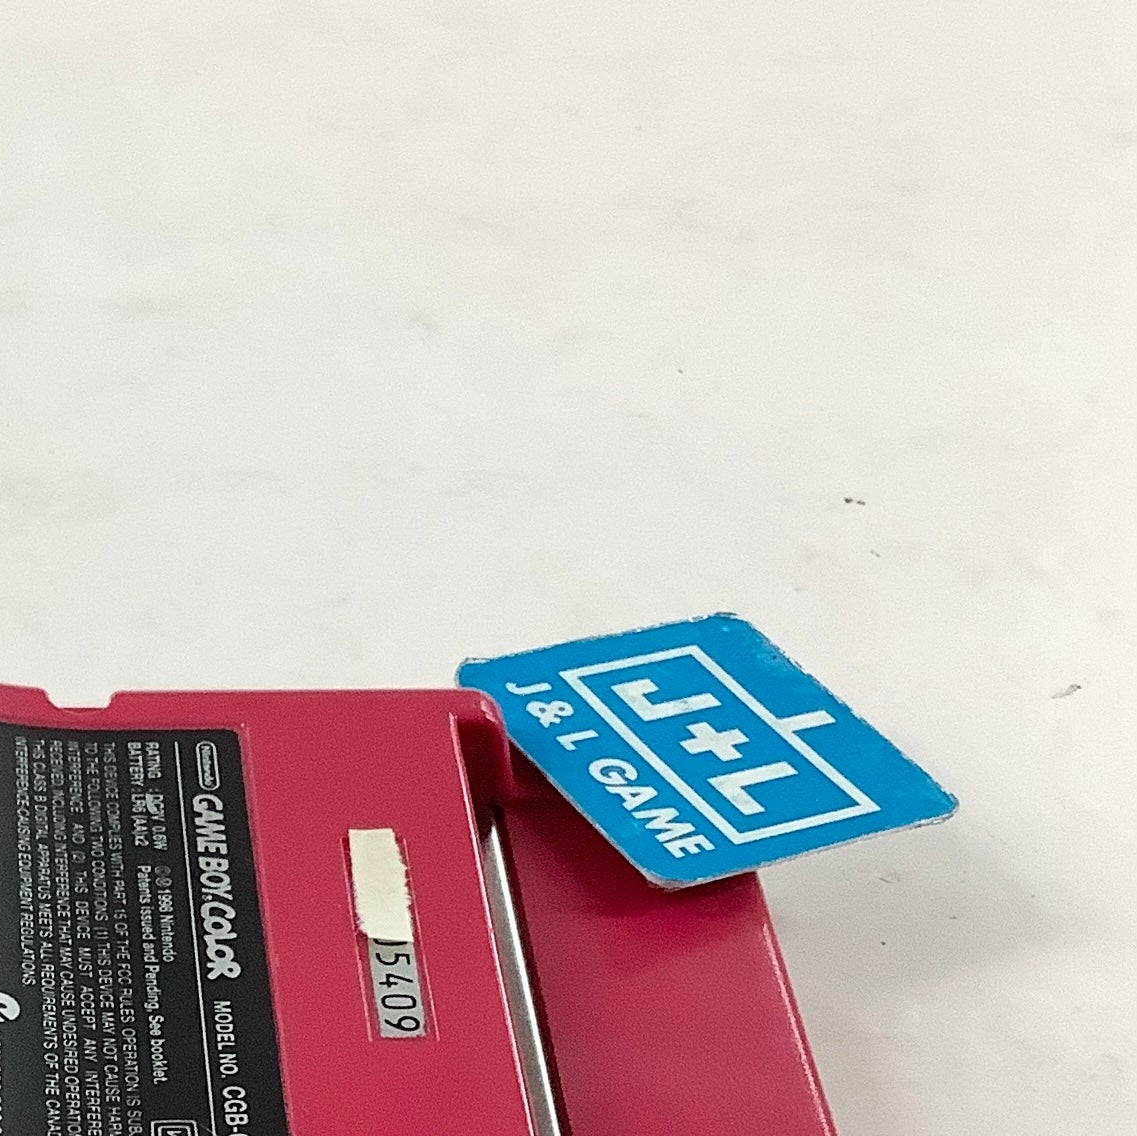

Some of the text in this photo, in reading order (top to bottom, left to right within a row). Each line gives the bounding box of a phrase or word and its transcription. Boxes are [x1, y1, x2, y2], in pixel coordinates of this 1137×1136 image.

[32, 740, 45, 758] THIS
[85, 743, 98, 754] TO
[104, 742, 116, 763] THIS
[146, 742, 161, 778] RATING
[33, 762, 46, 792] CLASS
[87, 758, 98, 774] THE
[128, 742, 144, 786] BATTERY
[201, 746, 214, 786] Nintendo
[505, 681, 715, 859] J & L GAME
[104, 766, 118, 799] DEVICE
[52, 790, 67, 840] INCLUDING
[88, 778, 102, 832] FOLLOWING
[35, 805, 48, 840] DIGITAL
[72, 824, 85, 844] AND
[106, 802, 122, 850] COMPLIES
[193, 794, 227, 854] GAME
[91, 836, 104, 856] TWO
[152, 826, 167, 850] 0.6W
[37, 844, 51, 899] APPARATUS
[71, 851, 86, 863] (2)
[111, 852, 124, 877] WITH
[18, 853, 33, 911] EQUIPMENT
[55, 844, 70, 917] INTERFERENCE
[75, 871, 88, 893] THIS
[114, 880, 126, 904] PART
[198, 857, 233, 900] BOY
[39, 903, 53, 938] MEETS
[76, 901, 90, 939] DEVICE
[114, 909, 127, 919] 15
[58, 920, 72, 945] THAT
[93, 926, 109, 939] (1)
[114, 923, 128, 936] OF
[160, 915, 176, 962] Nintendo
[200, 902, 241, 980] COLOR
[40, 941, 53, 959] ALL
[60, 948, 73, 968] MAY
[78, 948, 92, 978] MUST
[98, 943, 111, 965] THIS
[117, 940, 130, 959] THE
[60, 971, 75, 1006] CAUSE
[98, 969, 114, 1008] DEVICE
[118, 964, 132, 984] FCC
[137, 866, 168, 1084] Patents issued and Pending, See booklet.
[373, 938, 420, 1031] 5409
[41, 964, 58, 1049] REQUIREMENTS
[80, 986, 96, 1030] ACCEPT
[102, 1012, 115, 1034] MAY
[214, 1001, 235, 1050] MODEL
[62, 1010, 78, 1073] UNDESIRED
[84, 1038, 98, 1062] ANY
[103, 1038, 117, 1061] NOT
[44, 1053, 58, 1069] OF
[122, 1028, 139, 1091] OPERATION
[219, 1054, 238, 1078] NO.
[45, 1073, 59, 1095] THE
[104, 1065, 120, 1102] CAUSE
[126, 1096, 140, 1106] IS
